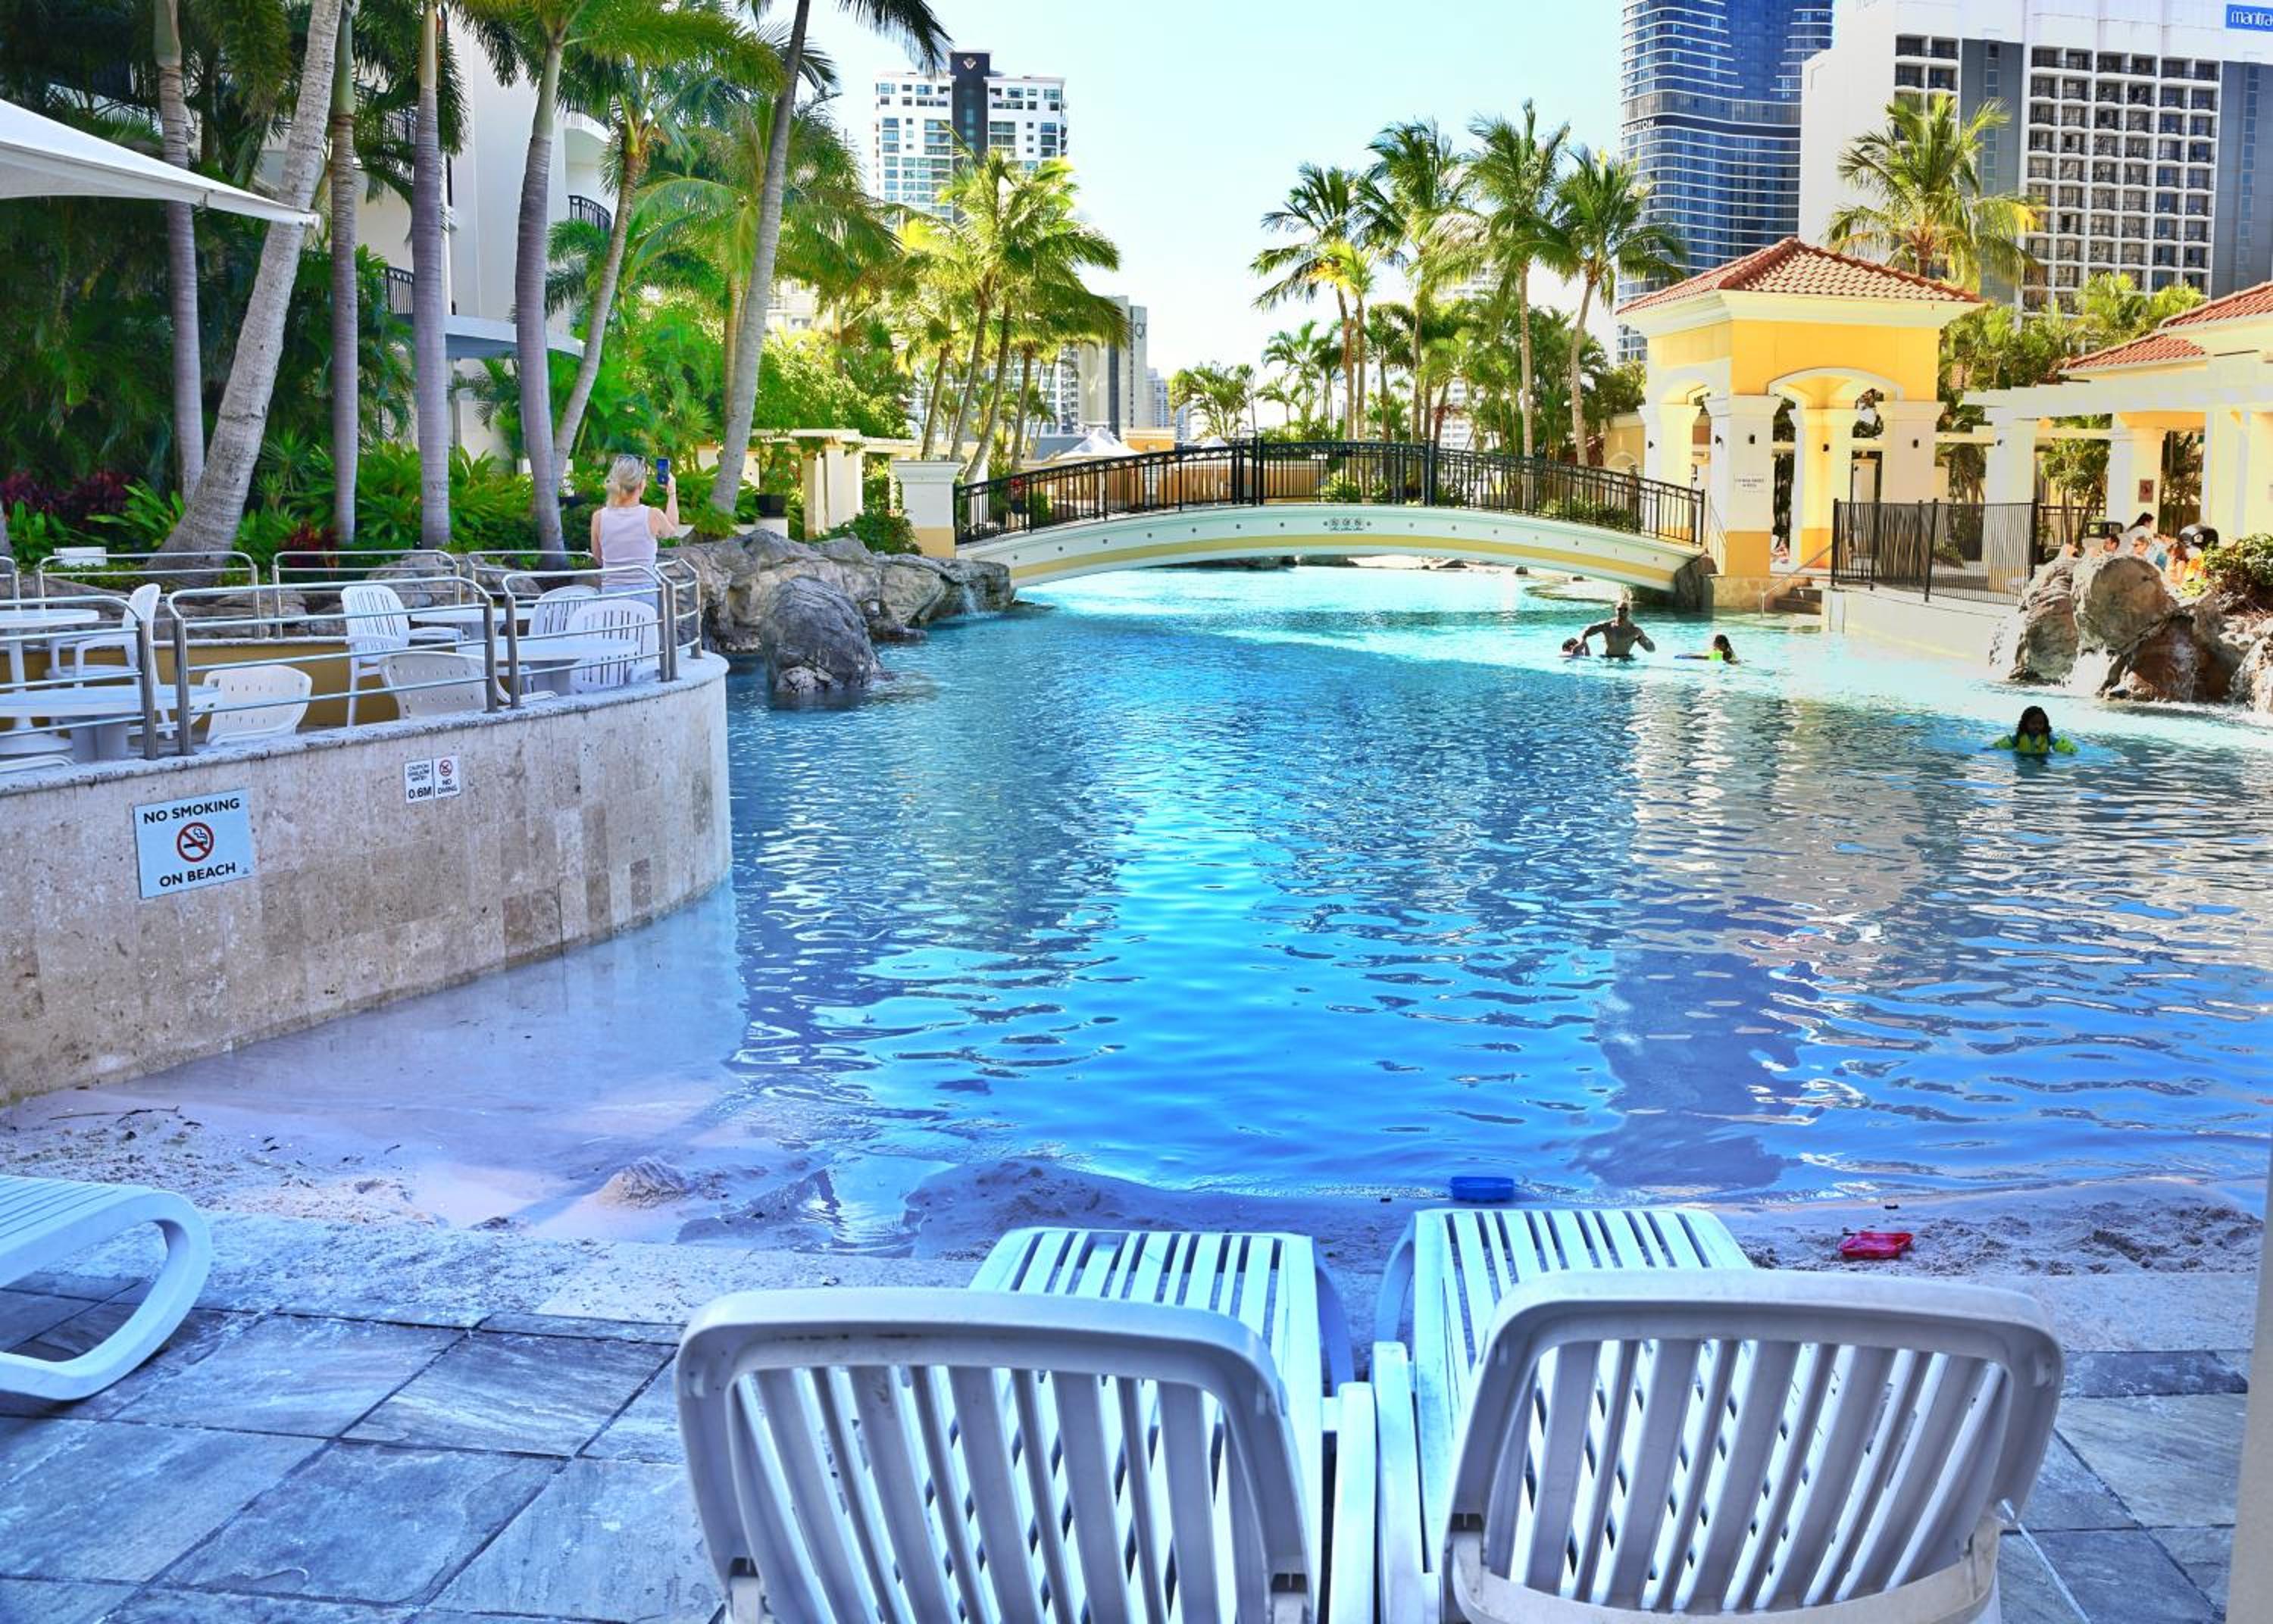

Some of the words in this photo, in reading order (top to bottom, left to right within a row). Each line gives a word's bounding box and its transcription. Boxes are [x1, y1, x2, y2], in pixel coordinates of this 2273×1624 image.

[2231, 11, 2272, 27] mantra
[143, 810, 167, 825] NO
[172, 798, 240, 820] SMOKING
[159, 872, 183, 887] ON
[187, 861, 236, 882] BEACH
